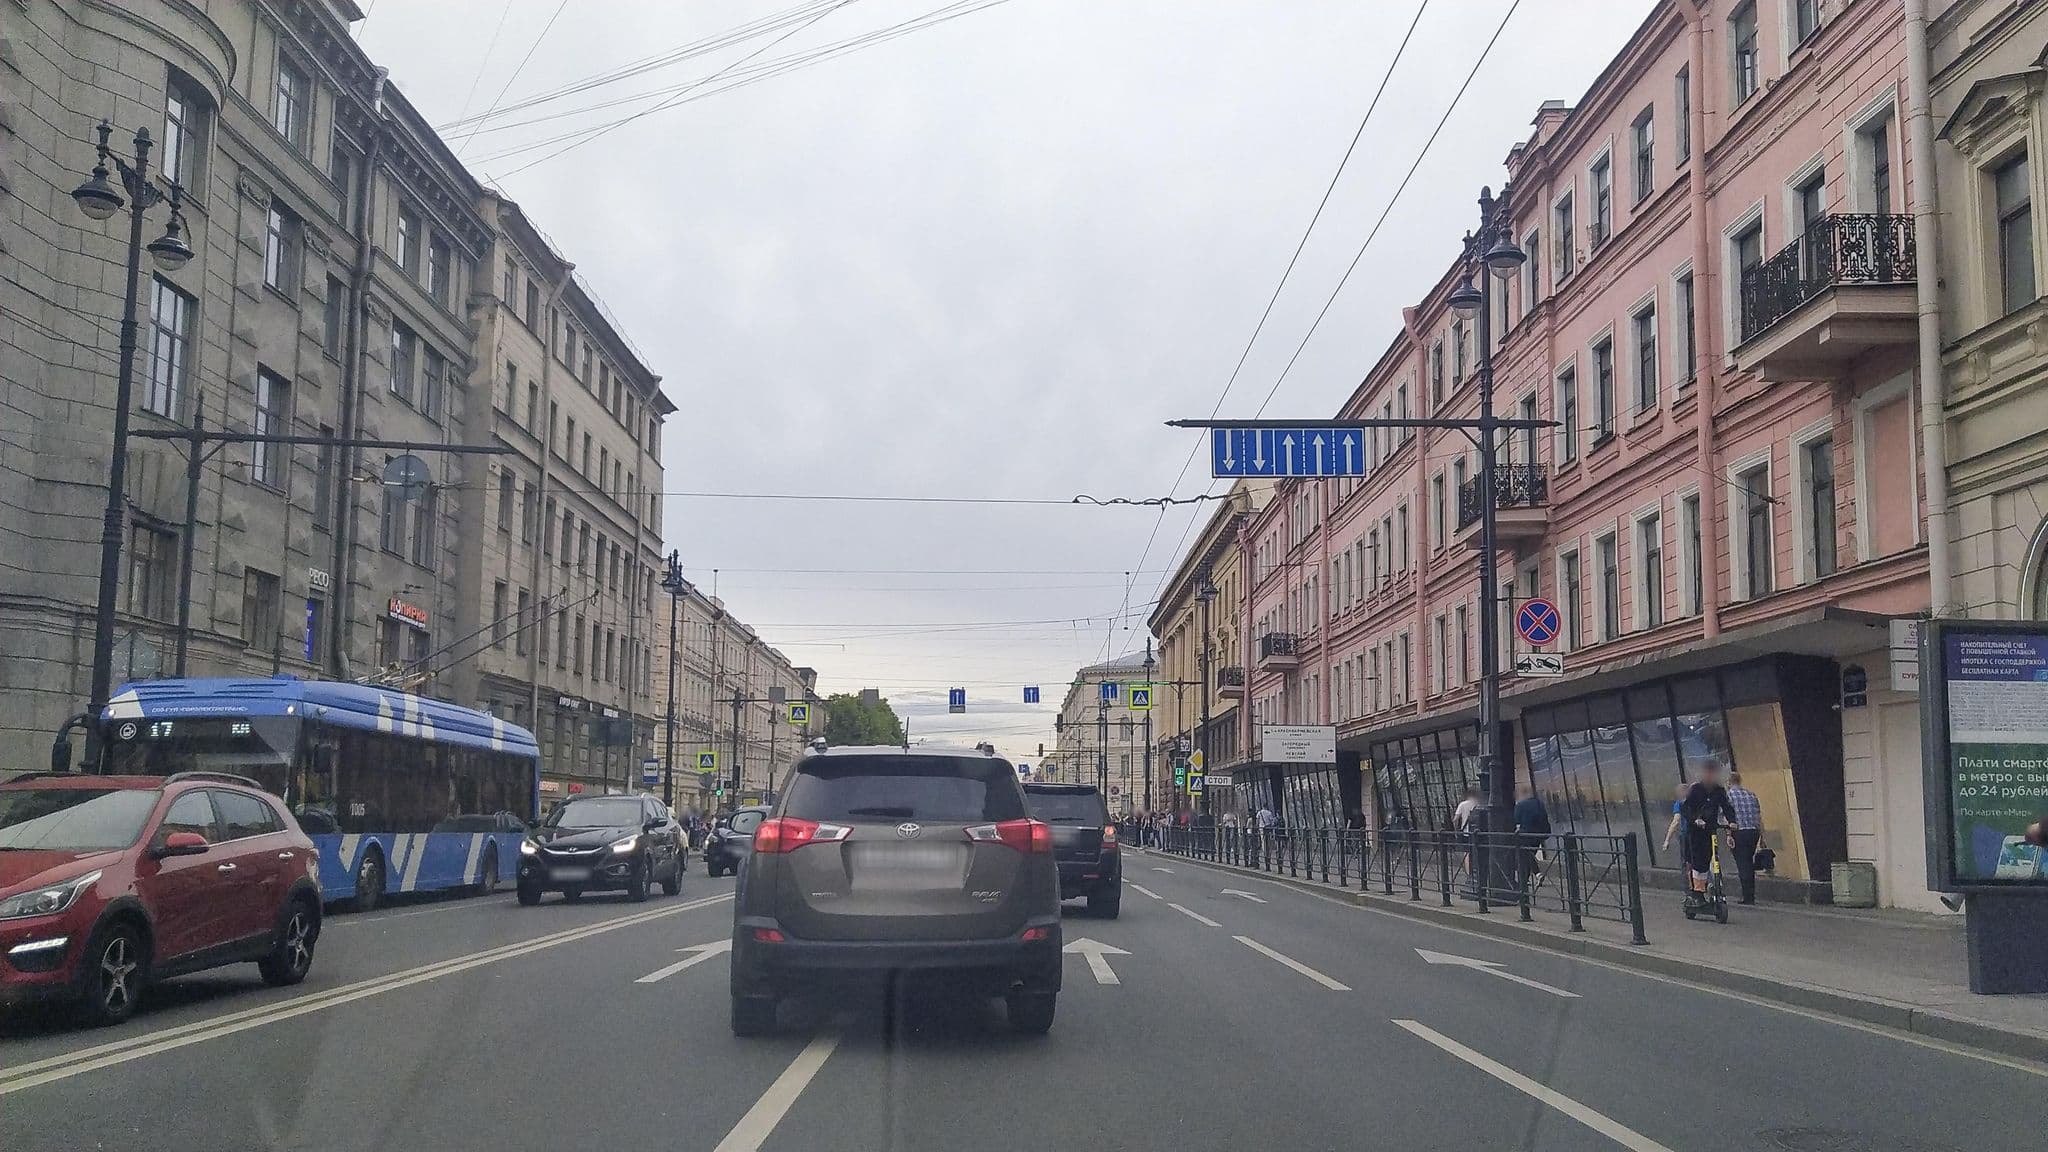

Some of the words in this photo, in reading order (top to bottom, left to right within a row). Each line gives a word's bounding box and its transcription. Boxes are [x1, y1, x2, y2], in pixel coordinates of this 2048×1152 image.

[390, 597, 427, 622] КОПИРКА
[1961, 667, 1999, 675] БЕСПЛАТНАЯ
[150, 721, 174, 737] 17
[1959, 757, 1999, 768] Плати
[1959, 773, 1967, 782] в
[1970, 773, 2013, 783] метро
[2016, 773, 2024, 782] с
[1960, 787, 1977, 797] до
[1981, 785, 1998, 796] 24
[2001, 785, 2048, 798] рублей
[1960, 808, 1974, 817] По
[1975, 808, 2001, 817] карте
